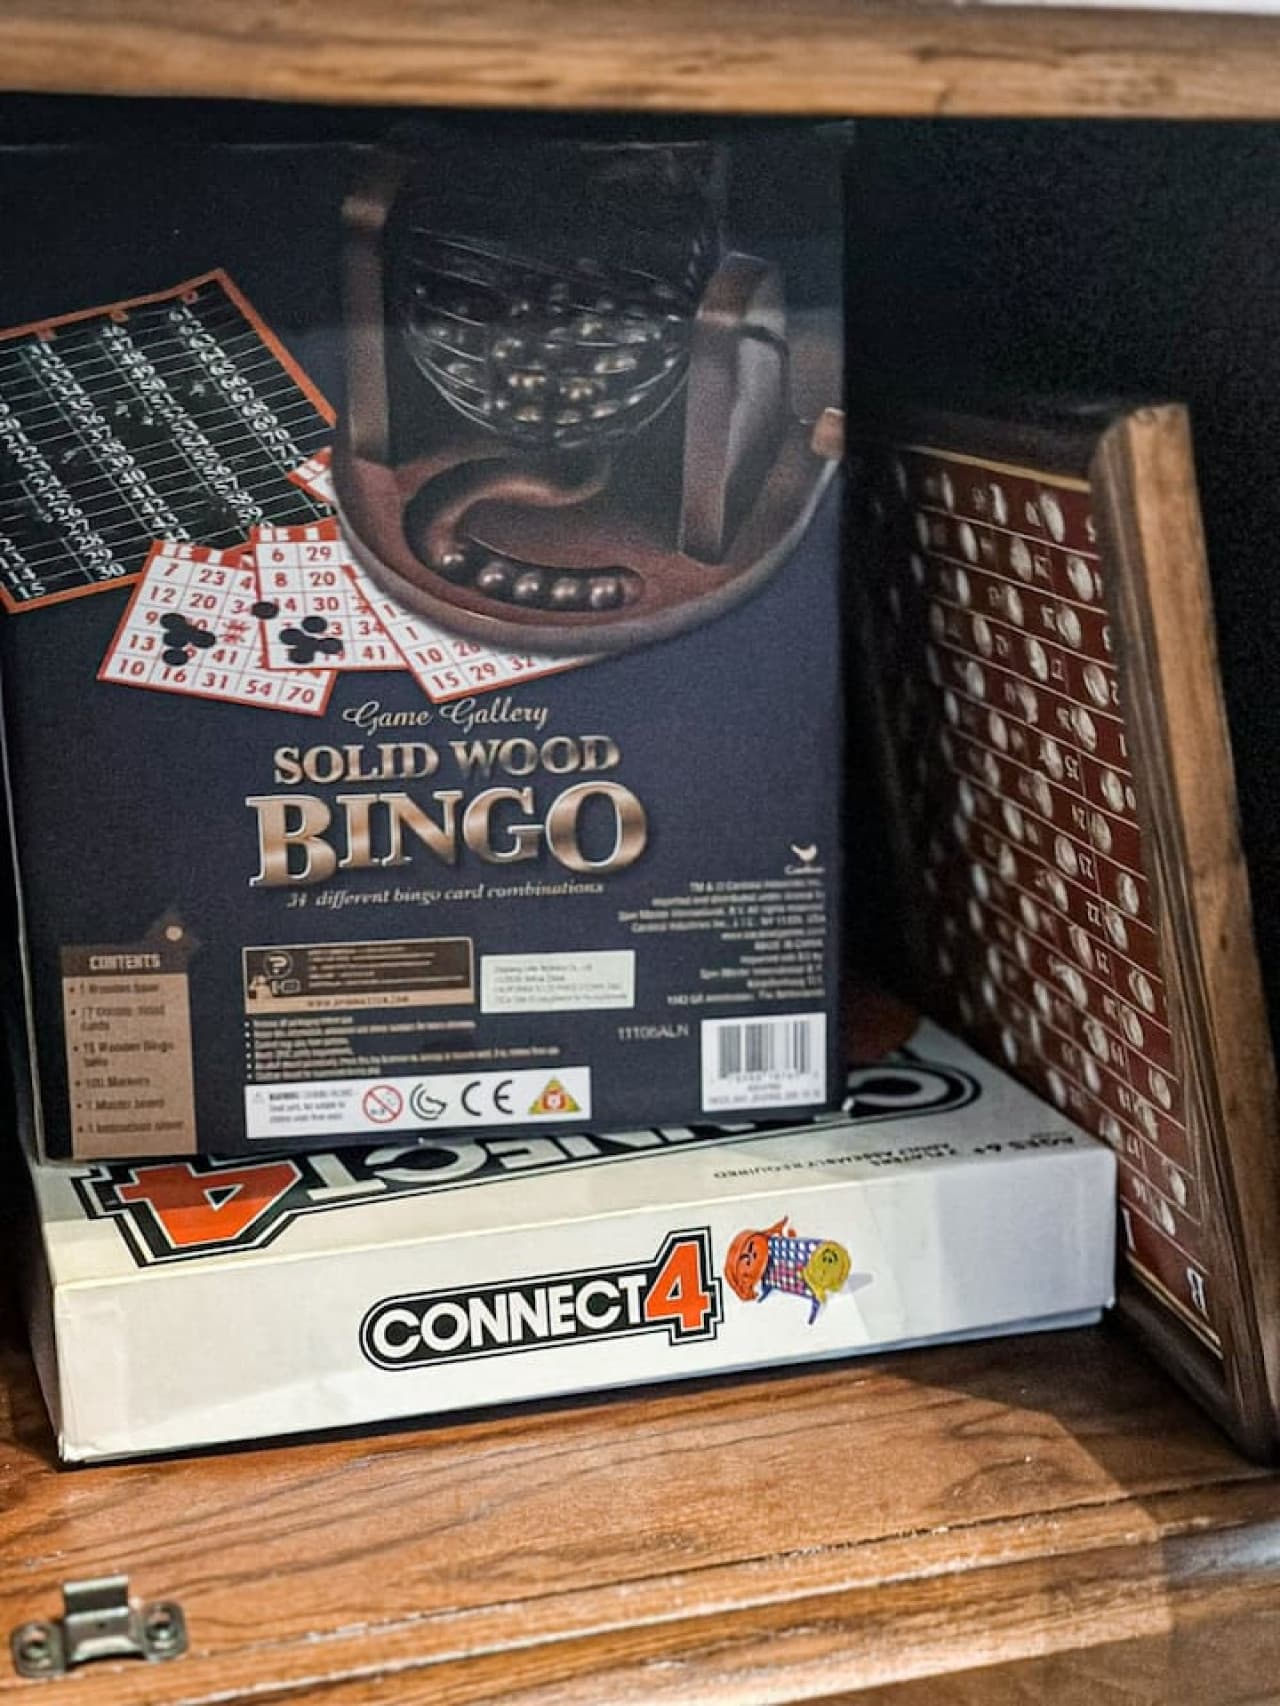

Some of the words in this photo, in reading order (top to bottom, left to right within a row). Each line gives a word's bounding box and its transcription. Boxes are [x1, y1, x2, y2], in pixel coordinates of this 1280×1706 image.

[231, 387, 254, 402] 67
[254, 416, 278, 430] 69
[262, 429, 290, 444] 70
[272, 444, 299, 458] 71
[119, 469, 146, 484] 40
[272, 549, 284, 562] 6
[306, 547, 331, 561] 29
[164, 564, 179, 577] 7
[200, 569, 225, 586] 23
[274, 573, 287, 587] 8
[310, 572, 336, 587] 20
[151, 586, 176, 603] 12
[190, 594, 217, 609] 20
[312, 597, 339, 612] 30
[145, 611, 158, 625] 9
[130, 634, 156, 651] 13
[213, 649, 238, 665] 41
[362, 646, 386, 660] 41
[416, 648, 443, 666] 10
[120, 659, 144, 676] 10
[162, 668, 186, 682] 16
[202, 673, 228, 689] 31
[246, 681, 272, 697] 54
[287, 688, 315, 704] 70
[432, 671, 461, 690] 15
[470, 663, 497, 682] 29
[343, 700, 431, 736] Game
[440, 698, 548, 735] Gallery
[274, 742, 439, 785] SOLID
[450, 735, 621, 778] WOOD
[245, 780, 648, 888] BINGO
[315, 889, 390, 909] different
[394, 887, 441, 905] bingo
[445, 884, 484, 900] card
[487, 879, 604, 899] combinations
[713, 1161, 806, 1179] REQUIRED
[116, 1162, 302, 1247] 4
[373, 1273, 647, 1360] CONNECT
[644, 1240, 711, 1336] 4
